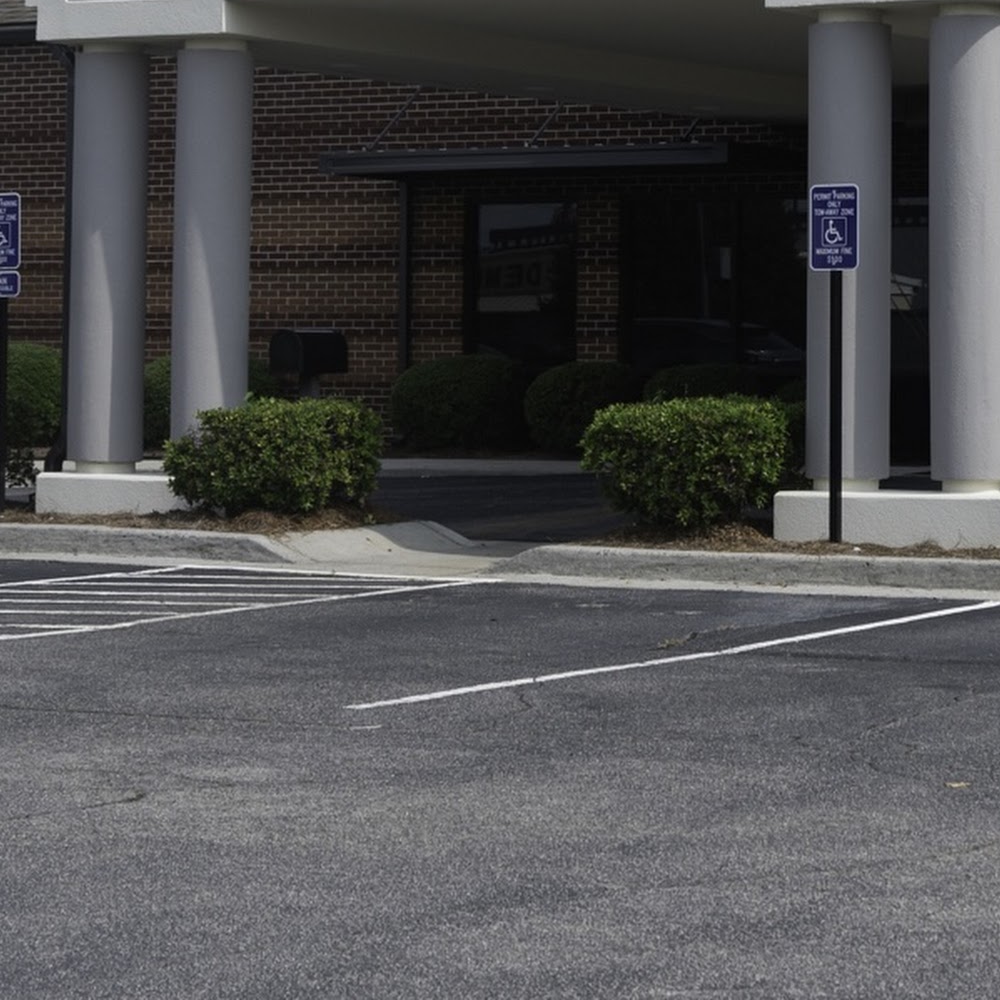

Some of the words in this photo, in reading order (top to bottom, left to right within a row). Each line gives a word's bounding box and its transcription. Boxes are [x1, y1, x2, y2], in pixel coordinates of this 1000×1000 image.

[827, 200, 841, 208] ONLY
[840, 207, 854, 215] ZONE
[840, 247, 853, 255] FINE
